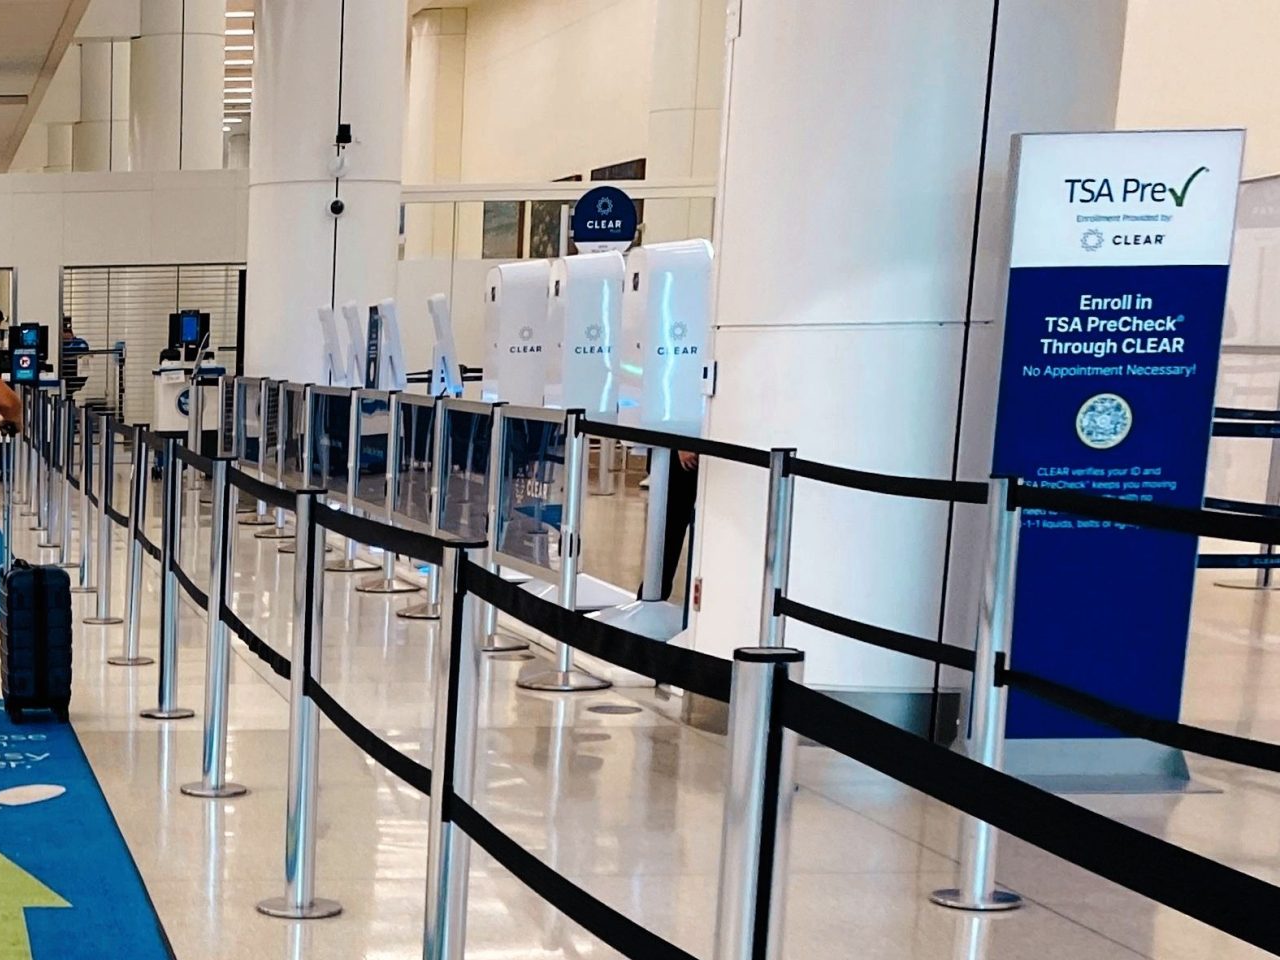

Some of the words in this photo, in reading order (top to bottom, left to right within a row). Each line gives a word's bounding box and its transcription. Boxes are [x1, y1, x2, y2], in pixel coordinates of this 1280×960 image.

[1064, 178, 1115, 203] TSA
[1122, 178, 1168, 203] Pre
[586, 220, 622, 229] CLEAR
[1111, 233, 1165, 246] CLEAR
[1079, 294, 1133, 310] Enroll
[1135, 293, 1153, 310] in
[1045, 316, 1083, 332] TSA
[509, 345, 543, 354] CLEAR
[1040, 338, 1118, 358] Through
[1121, 337, 1185, 353] CLEAR
[1022, 365, 1041, 377] No
[1044, 364, 1123, 379] Appointment
[1126, 363, 1197, 378] Necessary!
[1037, 467, 1070, 477] CLEAR
[1071, 467, 1105, 477] verifies
[1107, 468, 1128, 478] your
[1143, 467, 1162, 476] and
[1123, 481, 1140, 490] you
[1141, 481, 1177, 491] moving
